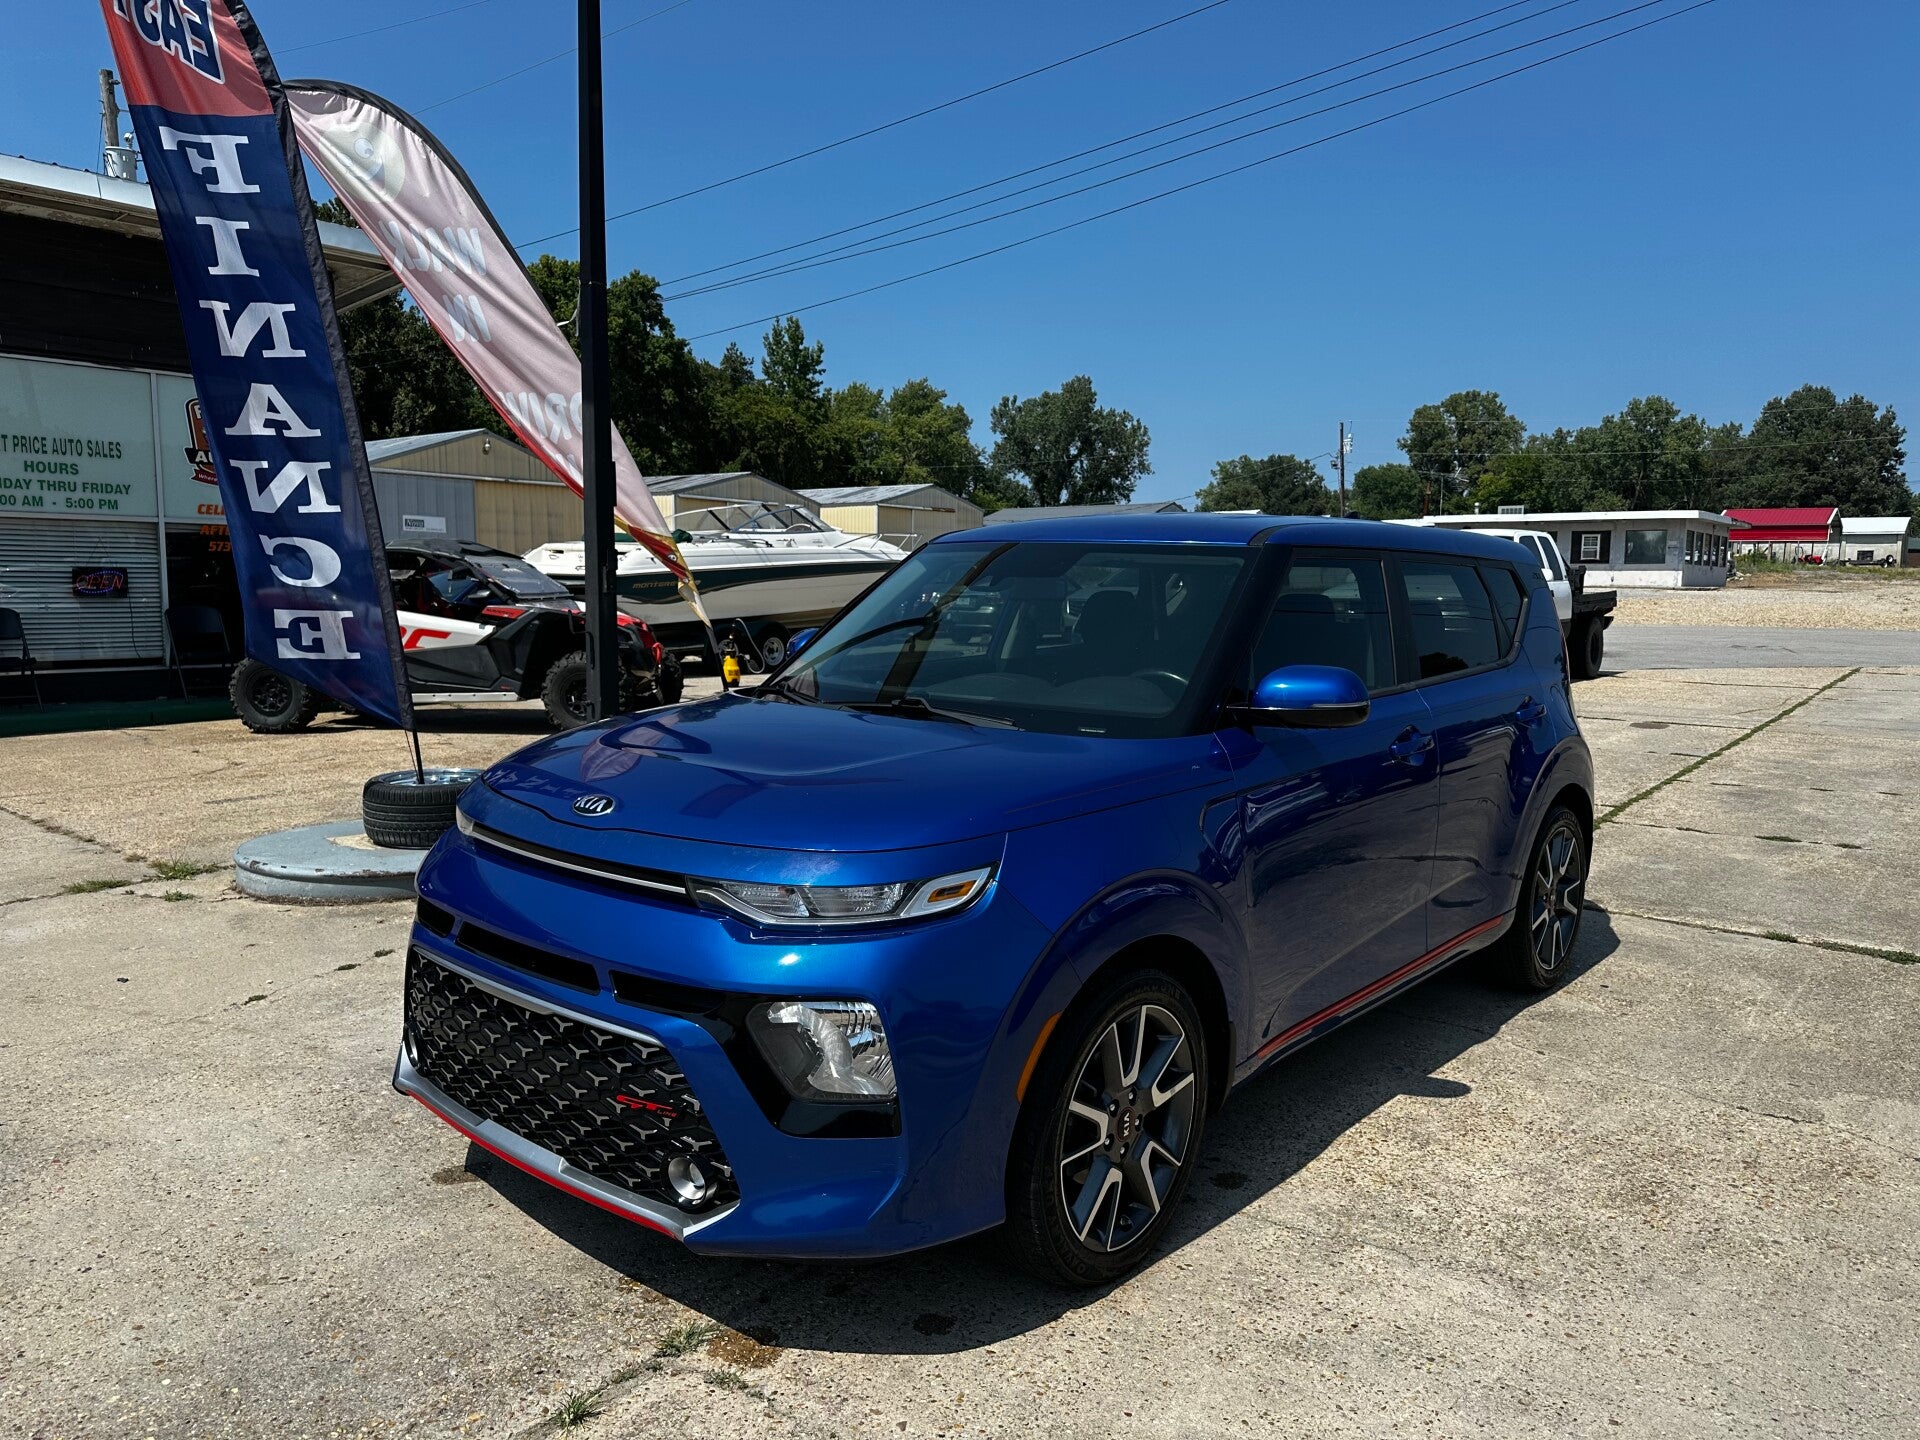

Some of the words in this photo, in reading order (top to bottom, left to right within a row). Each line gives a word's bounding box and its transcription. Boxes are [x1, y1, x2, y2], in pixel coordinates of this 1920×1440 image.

[12, 435, 48, 454] PRICE
[52, 438, 83, 457] AUTO
[87, 440, 122, 459] SALES
[24, 460, 79, 475] HOURS
[0, 477, 32, 490] DAY
[37, 480, 77, 492] THRU
[82, 482, 131, 495] FRIDAY
[22, 495, 43, 507] AM
[65, 498, 94, 509] 5:00
[98, 499, 119, 510] PM
[76, 574, 123, 589] OPEN
[575, 796, 607, 812] KIA
